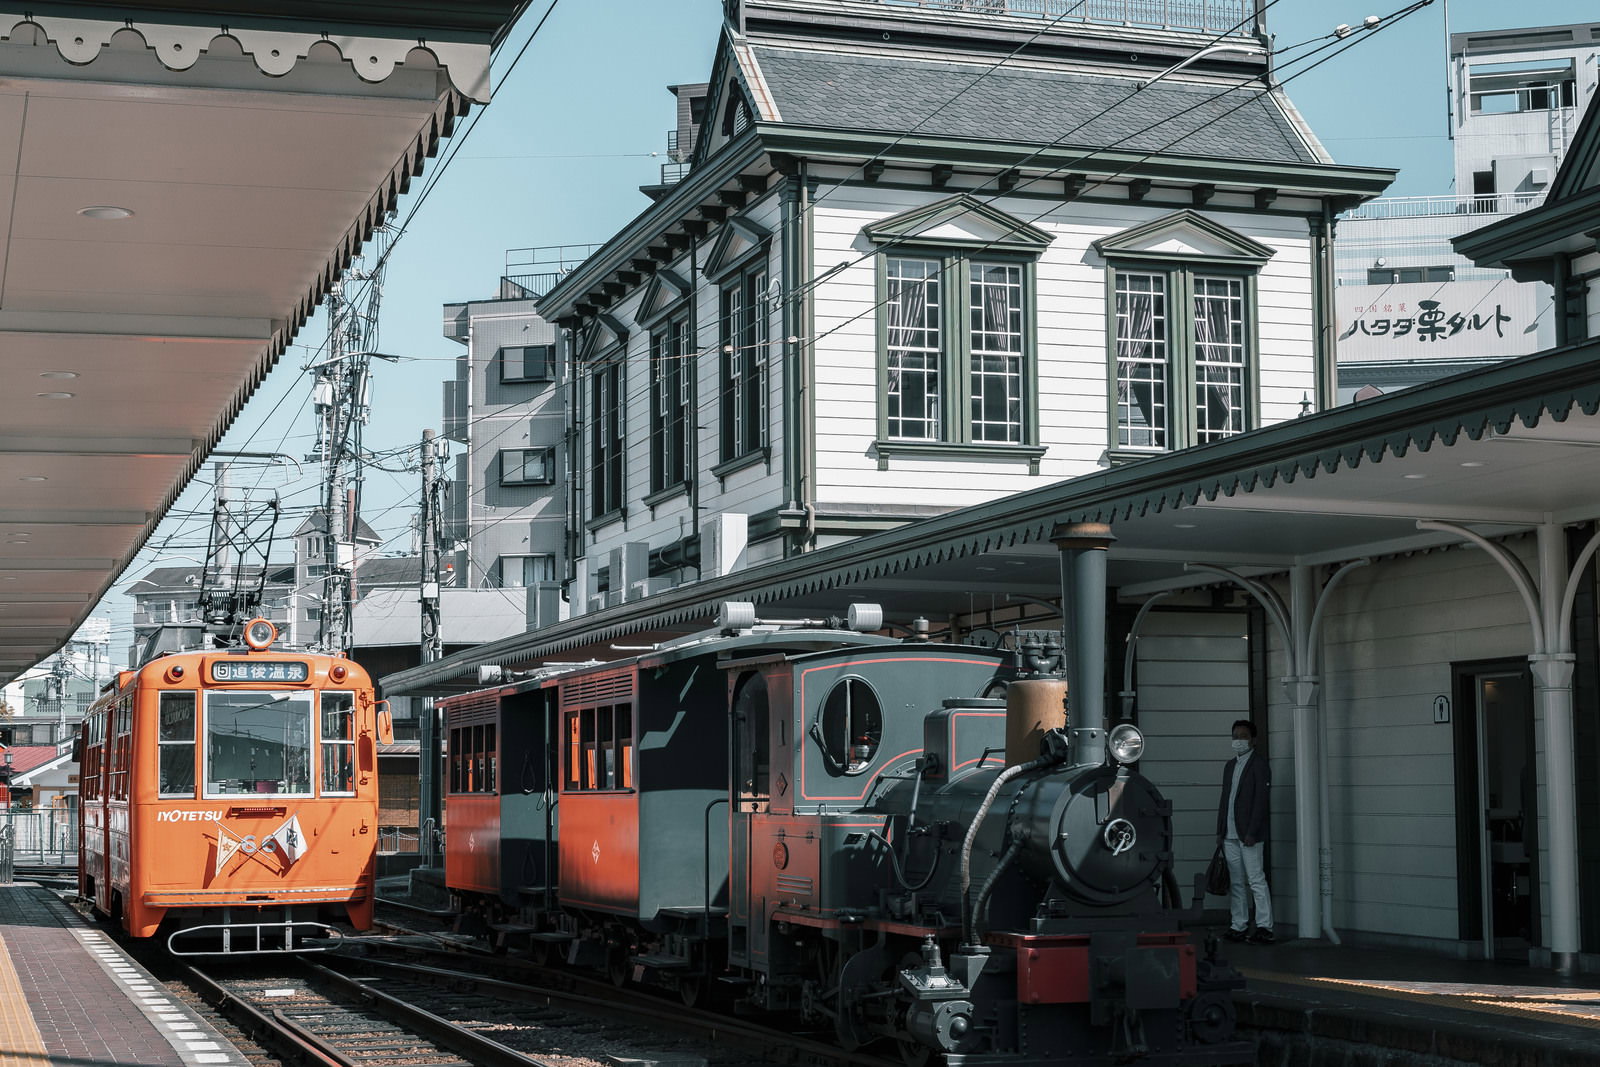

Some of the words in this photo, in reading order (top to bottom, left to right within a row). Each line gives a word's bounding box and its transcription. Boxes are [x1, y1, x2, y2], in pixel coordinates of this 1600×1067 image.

[1354, 303, 1407, 313] 四国銘菓
[1349, 300, 1511, 342] ハタダ栗タルト
[232, 663, 303, 679] 道後温泉
[157, 810, 223, 822] IYOTETSU
